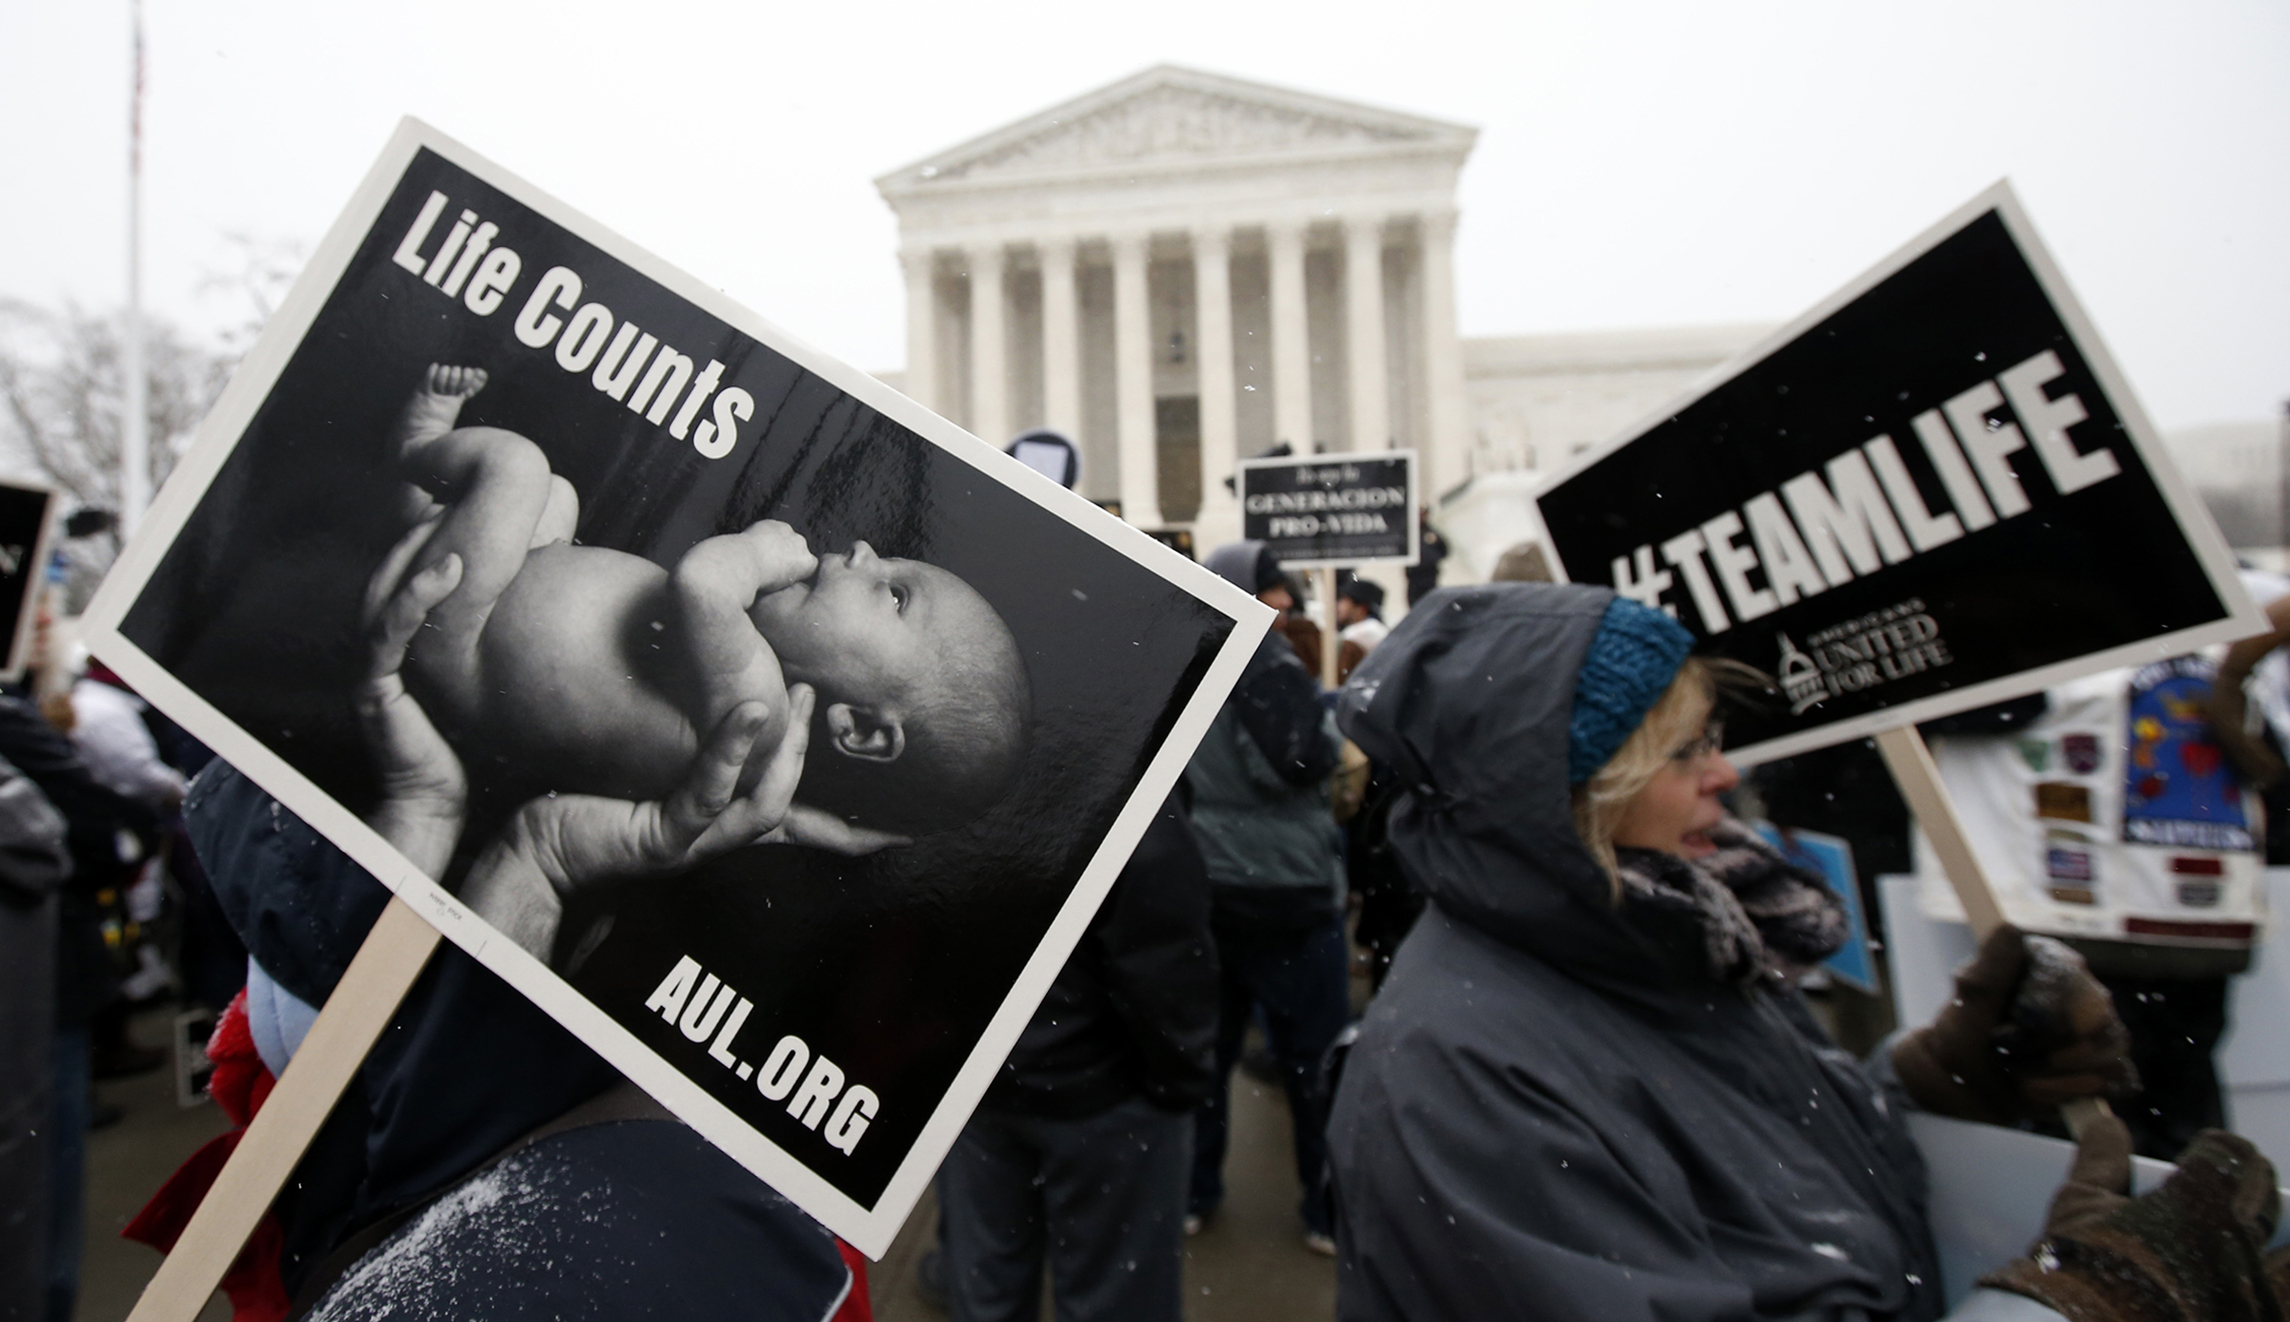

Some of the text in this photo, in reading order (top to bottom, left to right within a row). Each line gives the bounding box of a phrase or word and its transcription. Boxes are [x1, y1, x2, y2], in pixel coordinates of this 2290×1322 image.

[392, 189, 755, 460] Life Counts
[1246, 486, 1405, 515] GENERACION
[1611, 349, 2122, 635] #TEAMLIFE
[1269, 512, 1388, 538] PRO-VIDA
[1813, 613, 1939, 673] UNITED
[1824, 638, 1954, 697] FOR LIFE
[644, 954, 880, 1157] AUL.ORG
